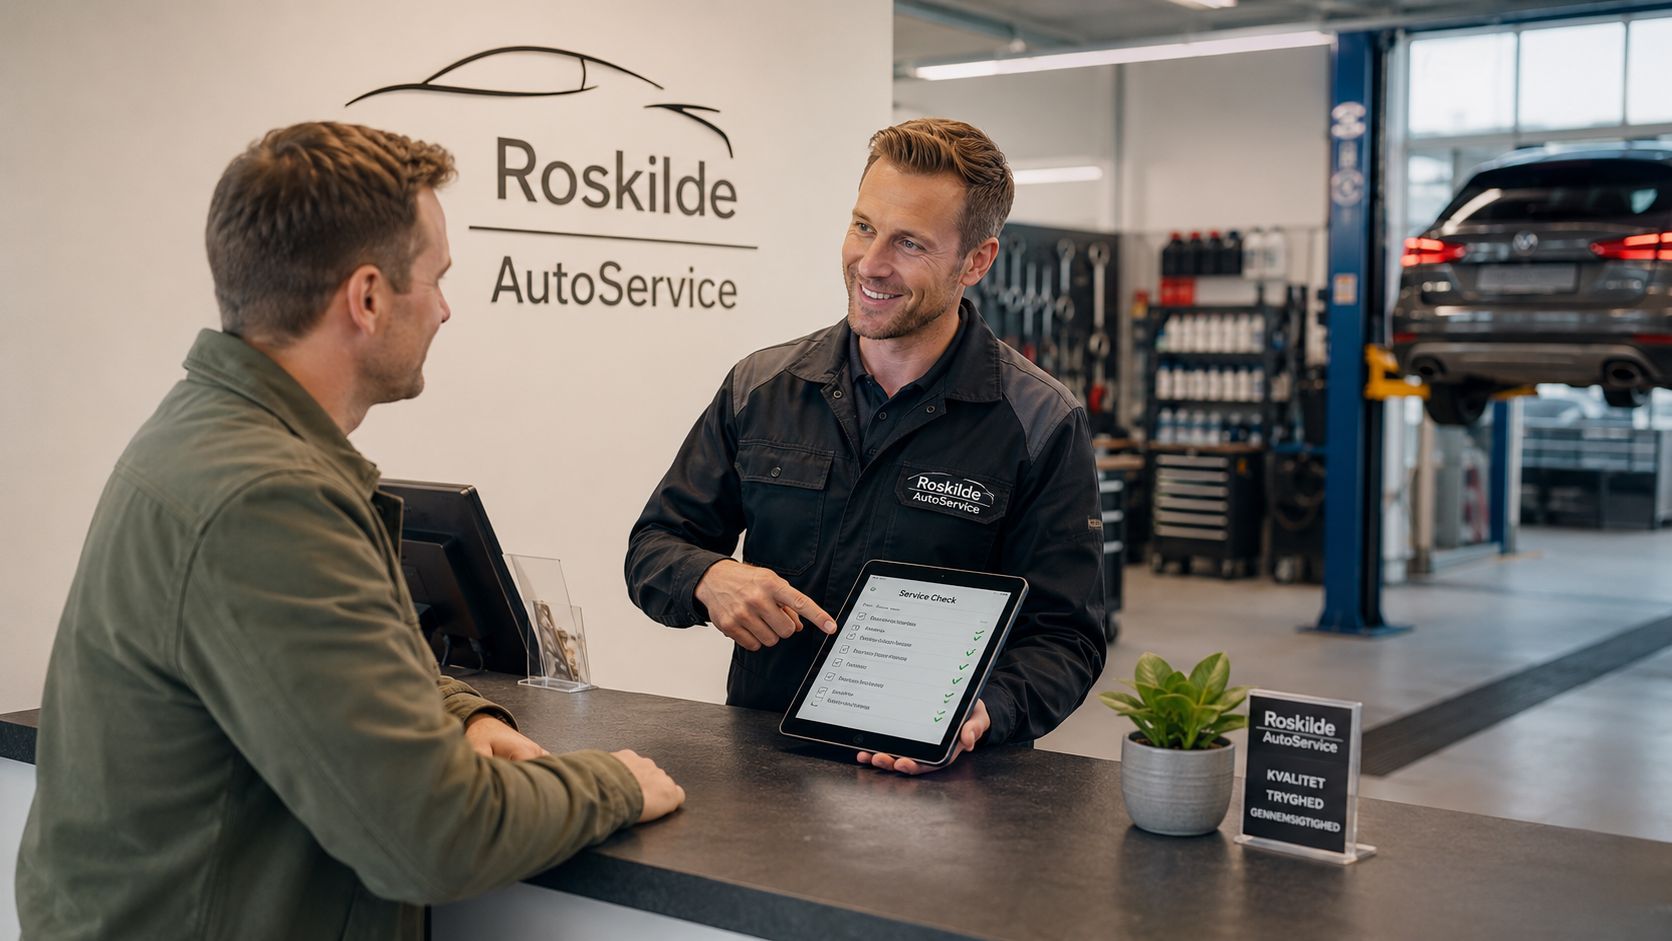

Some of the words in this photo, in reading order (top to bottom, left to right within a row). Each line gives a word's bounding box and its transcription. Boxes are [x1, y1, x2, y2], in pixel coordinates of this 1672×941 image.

[497, 136, 737, 219] Roskilde
[491, 256, 737, 309] AutoService
[916, 476, 982, 501] Roskilde
[913, 492, 980, 514] AutoService
[899, 589, 930, 601] Service
[930, 593, 957, 605] Check
[1264, 710, 1336, 736] Roskilde
[1262, 731, 1338, 753] AutoService
[1266, 769, 1326, 789] KVALITET
[1266, 789, 1325, 810] TRYGHED
[1250, 807, 1341, 833] GENNEMSIGTIGHED
